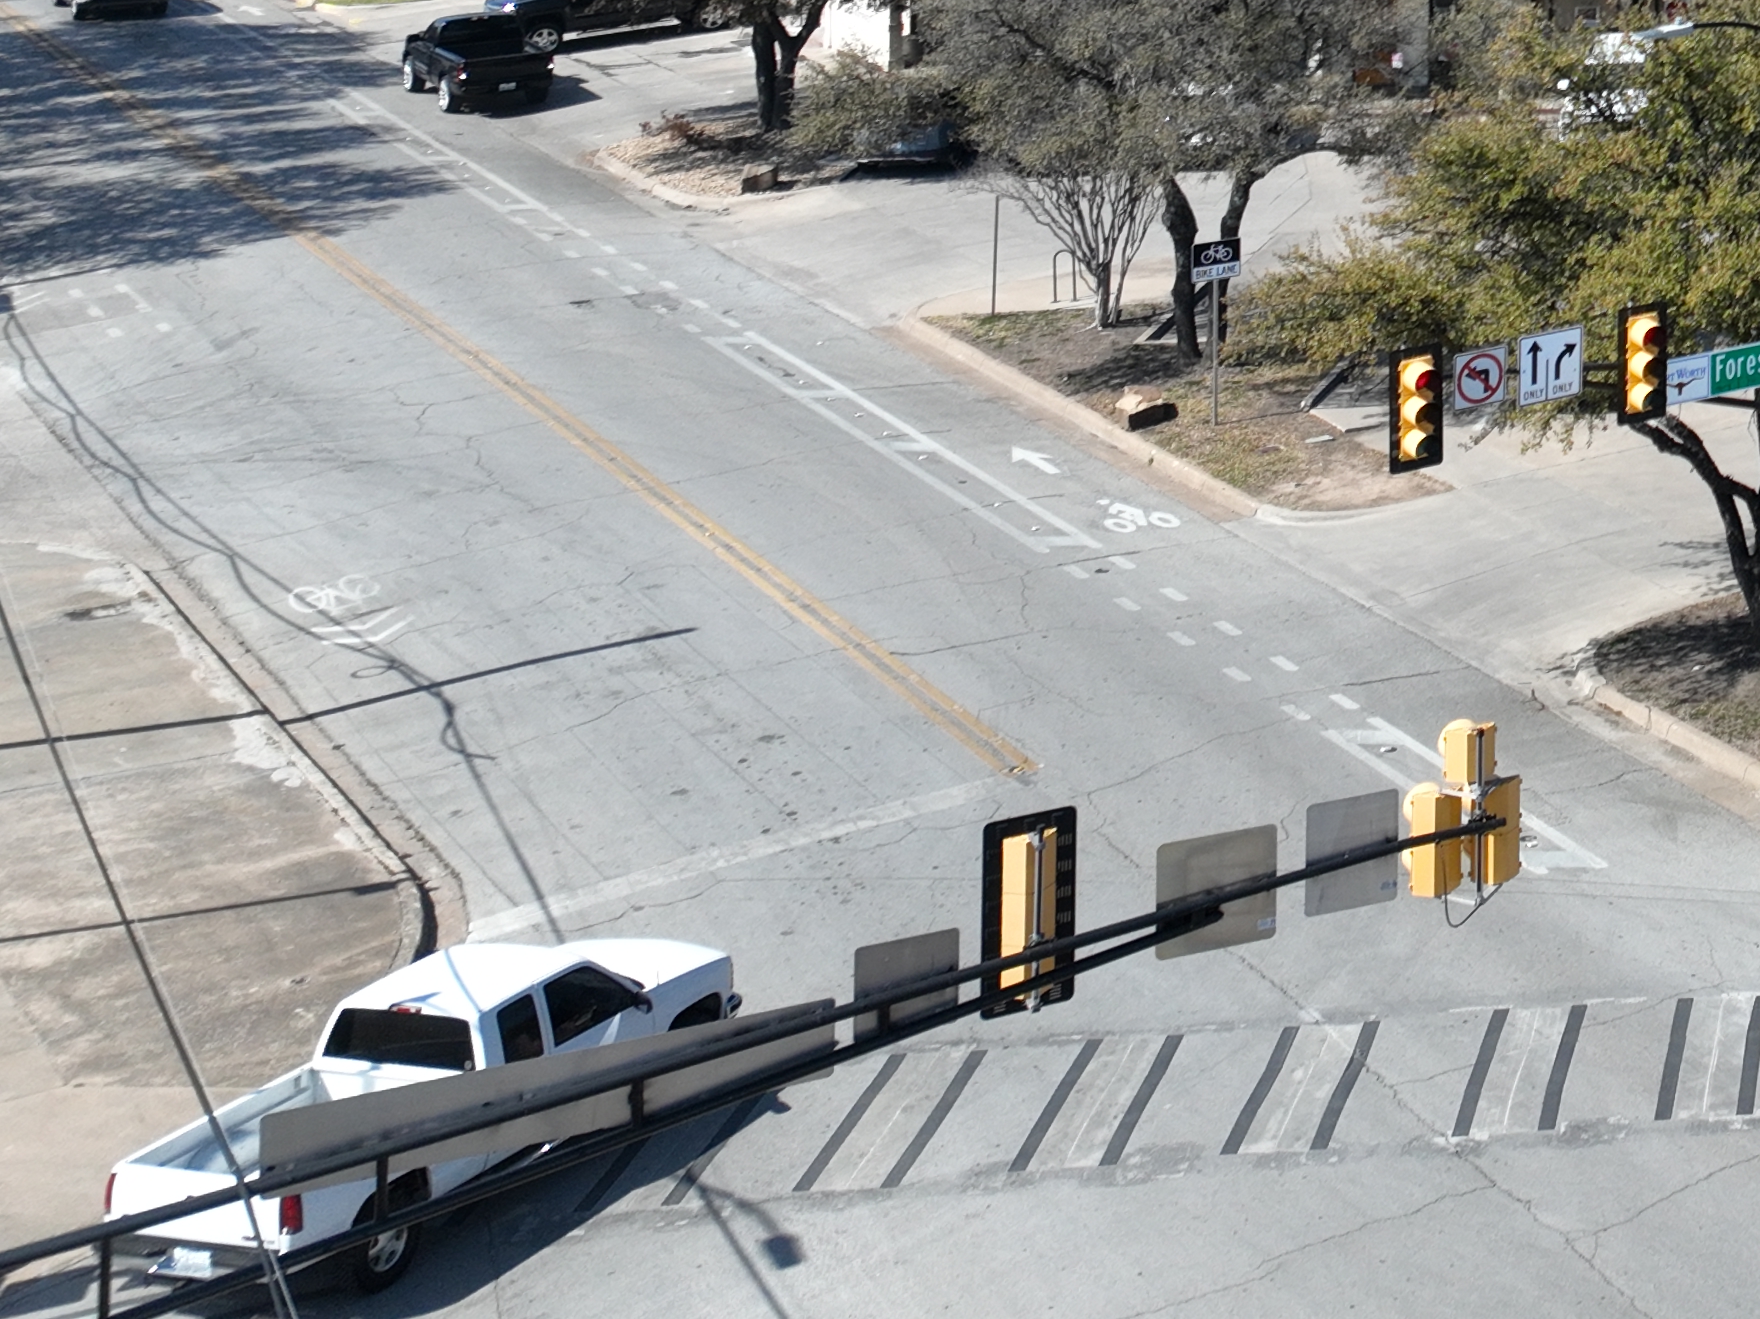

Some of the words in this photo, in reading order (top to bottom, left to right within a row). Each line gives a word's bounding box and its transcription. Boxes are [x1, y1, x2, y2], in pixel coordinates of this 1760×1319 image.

[1195, 267, 1214, 280] BIKE
[1216, 263, 1238, 276] LANE
[1522, 388, 1545, 402] ONLY
[1552, 381, 1574, 396] ONLY
